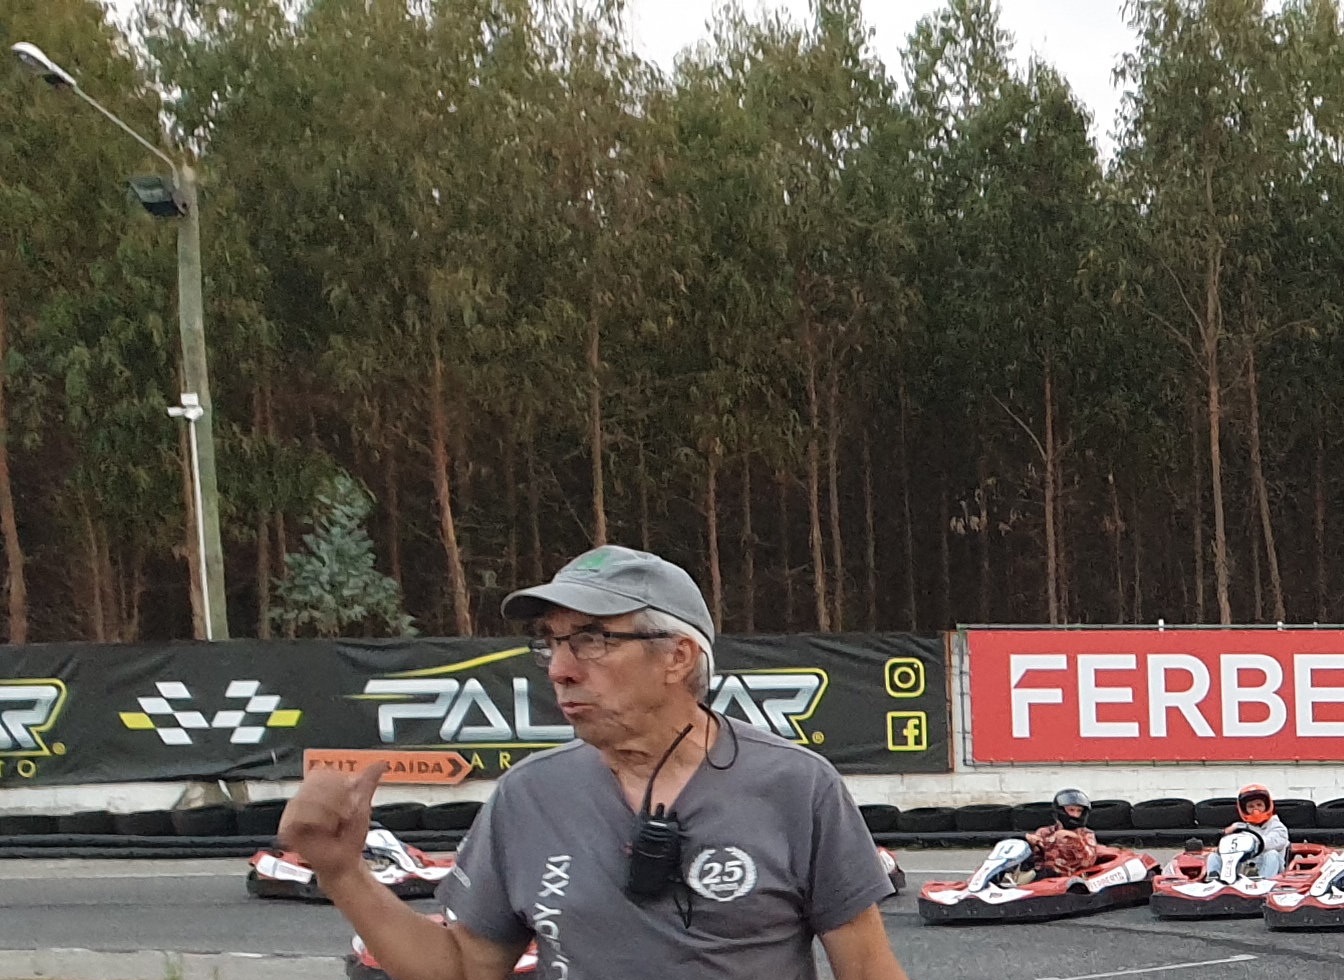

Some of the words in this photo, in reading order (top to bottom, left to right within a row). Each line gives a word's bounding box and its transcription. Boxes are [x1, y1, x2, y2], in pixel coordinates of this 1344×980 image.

[1230, 838, 1239, 851] 5
[538, 855, 572, 898] XXI
[701, 861, 744, 884] 25
